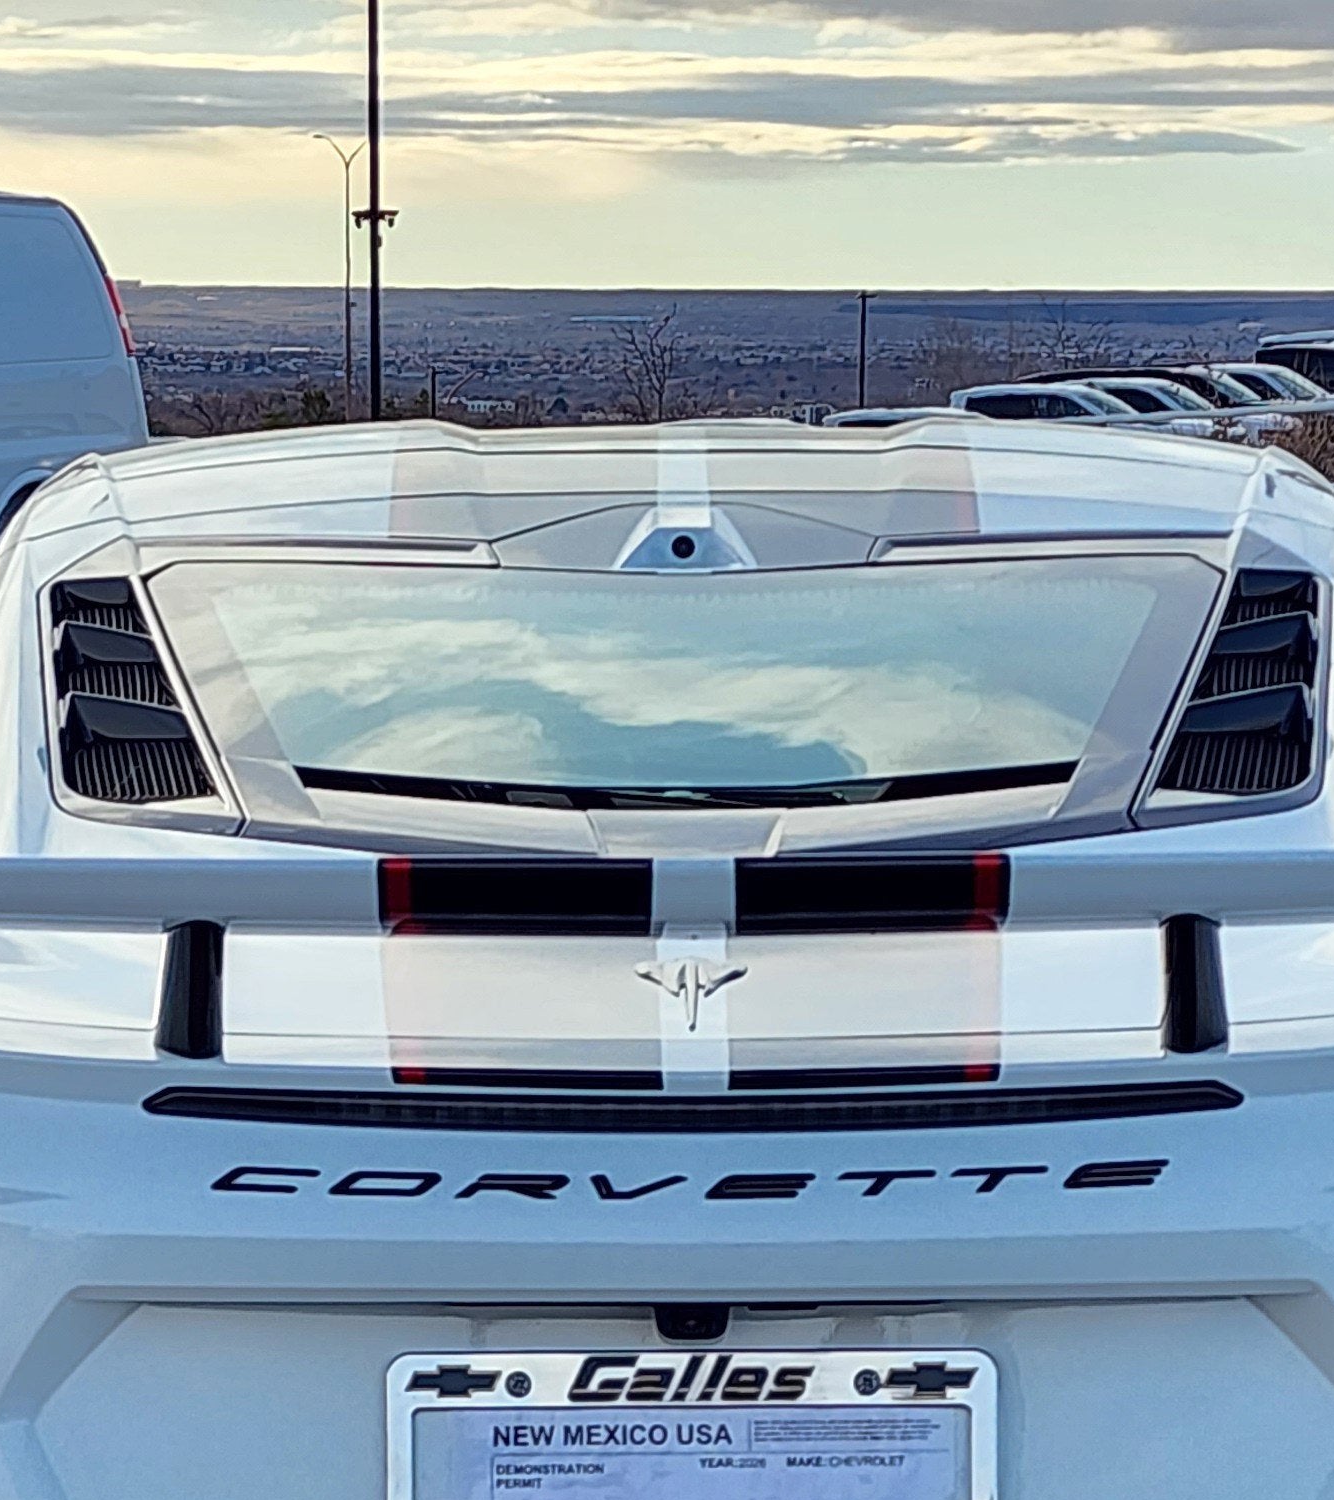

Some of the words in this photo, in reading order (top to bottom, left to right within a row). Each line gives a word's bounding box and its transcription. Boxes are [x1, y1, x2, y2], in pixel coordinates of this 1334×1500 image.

[211, 1159, 1170, 1200] CORVETTE
[567, 1355, 815, 1402] Galles
[493, 1426, 555, 1446] NEW
[563, 1425, 668, 1445] MEXICO
[676, 1424, 733, 1444] USA
[496, 1463, 605, 1475] DEMONSTRATION
[496, 1477, 542, 1488] PERMIT
